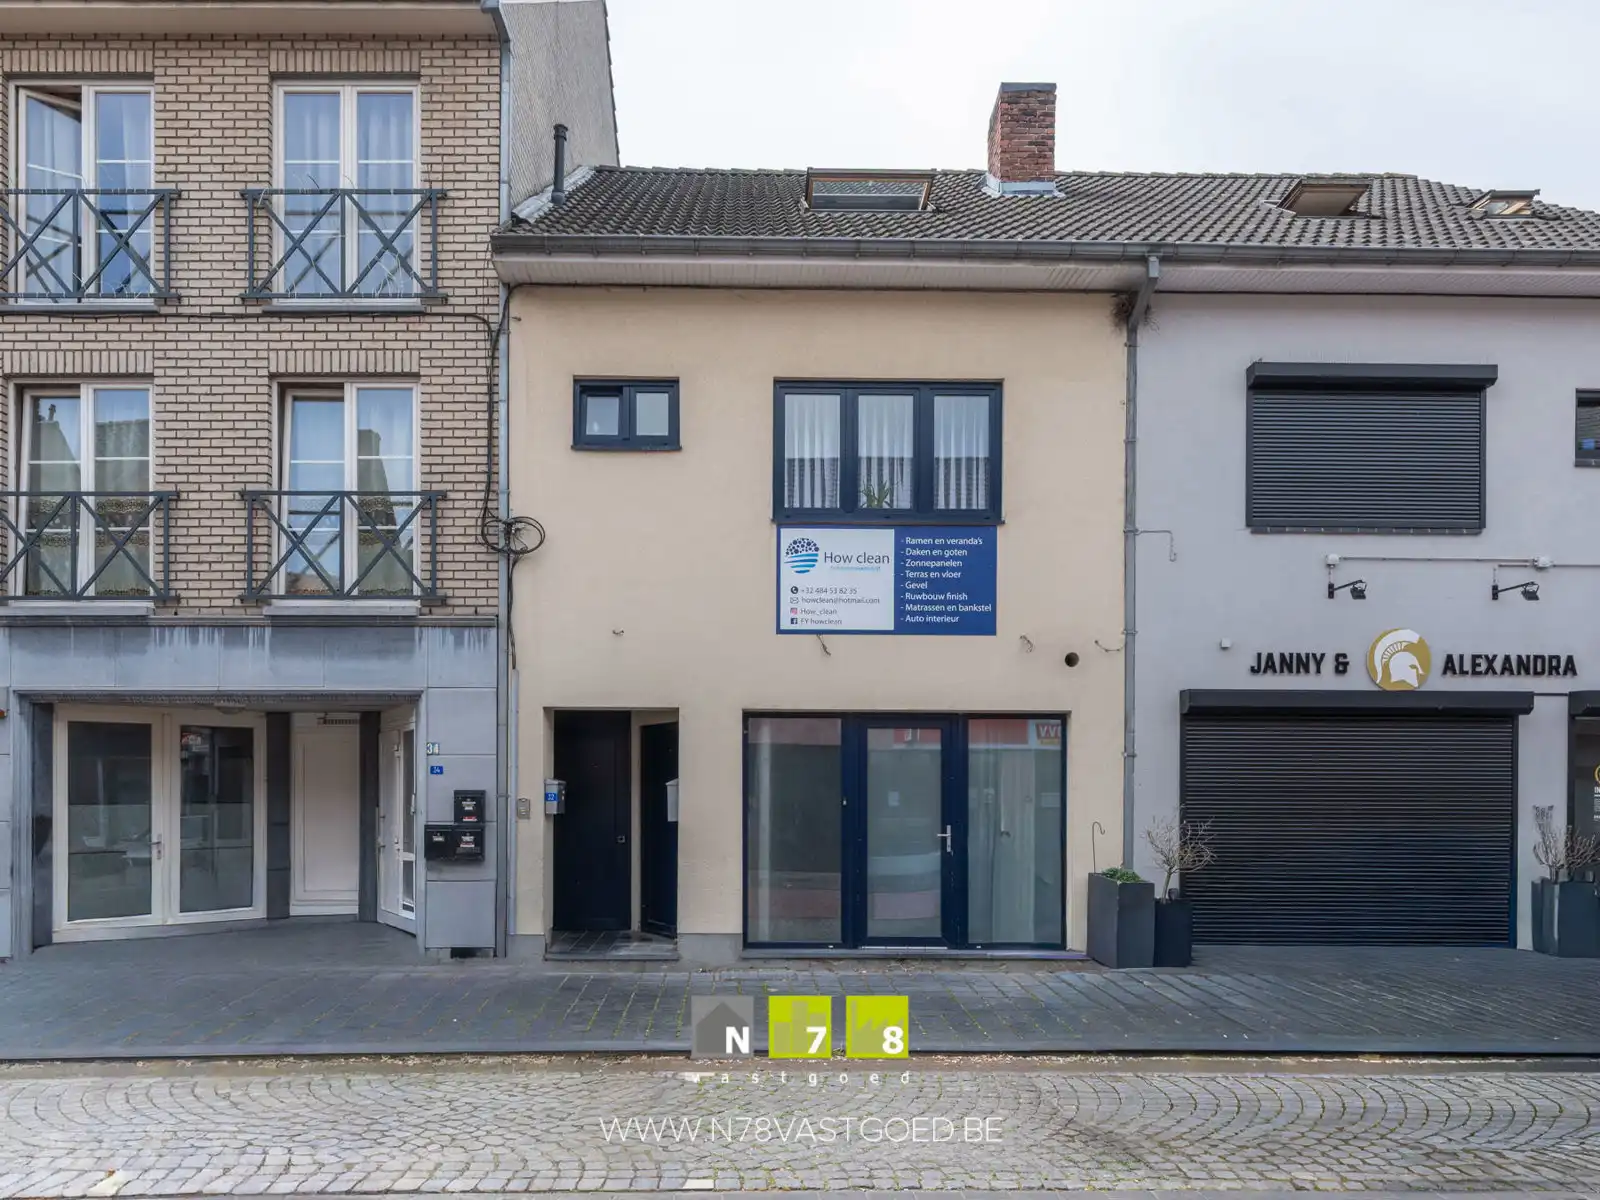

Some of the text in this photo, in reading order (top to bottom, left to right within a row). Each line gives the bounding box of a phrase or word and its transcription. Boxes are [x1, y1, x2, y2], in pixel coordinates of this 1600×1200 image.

[905, 536, 933, 545] Ramen
[946, 536, 983, 545] veranda's
[824, 551, 890, 564] How clean
[905, 548, 931, 556] Daken
[944, 549, 968, 558] goten
[905, 559, 963, 568] Zonnepanelen
[905, 570, 929, 578] Terras
[941, 570, 961, 578] vloer
[905, 581, 928, 589] Gevel
[905, 592, 968, 600] Ruwbouw finish
[905, 603, 945, 612] Matrassen
[958, 603, 992, 612] bankstel
[905, 615, 960, 623] Auto interieur
[1250, 652, 1578, 677] JANNY & ALEXANDRA
